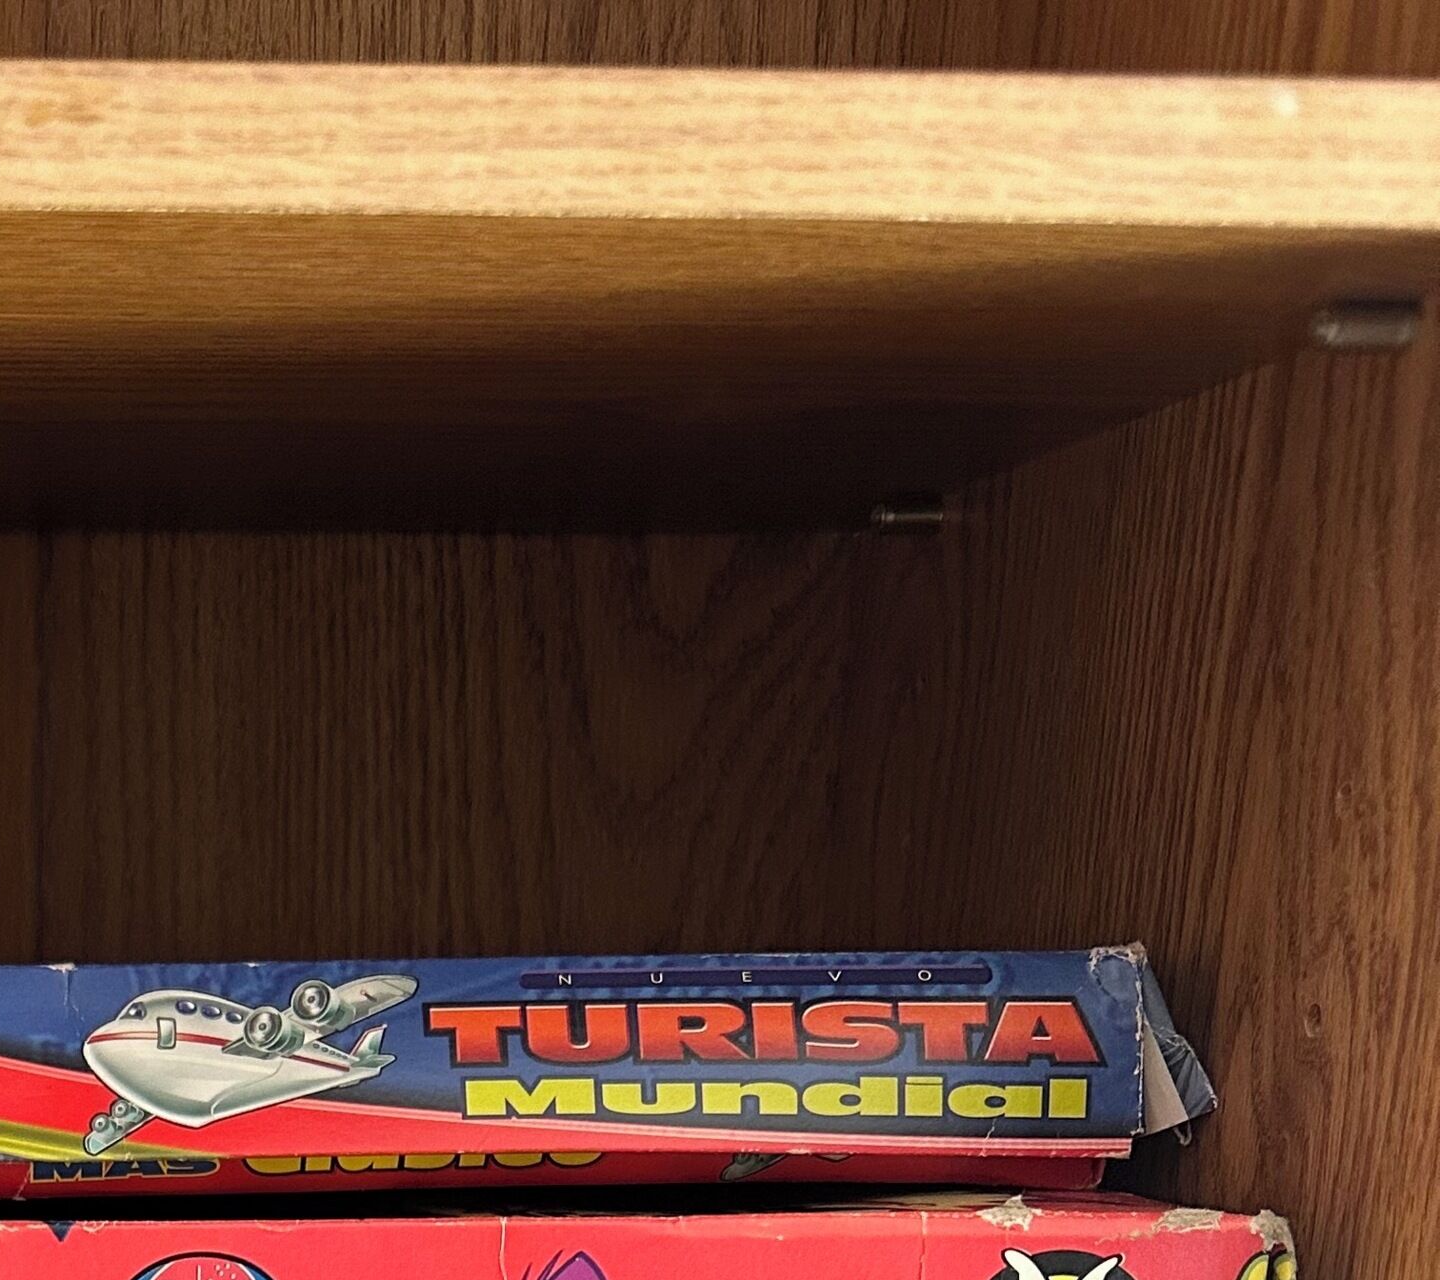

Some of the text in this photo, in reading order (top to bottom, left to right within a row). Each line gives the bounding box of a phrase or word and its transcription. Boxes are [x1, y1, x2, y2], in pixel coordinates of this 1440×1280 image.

[558, 968, 932, 987] NUEVO
[426, 1000, 1102, 1064] TURISTA
[464, 1076, 1088, 1119] Mundial
